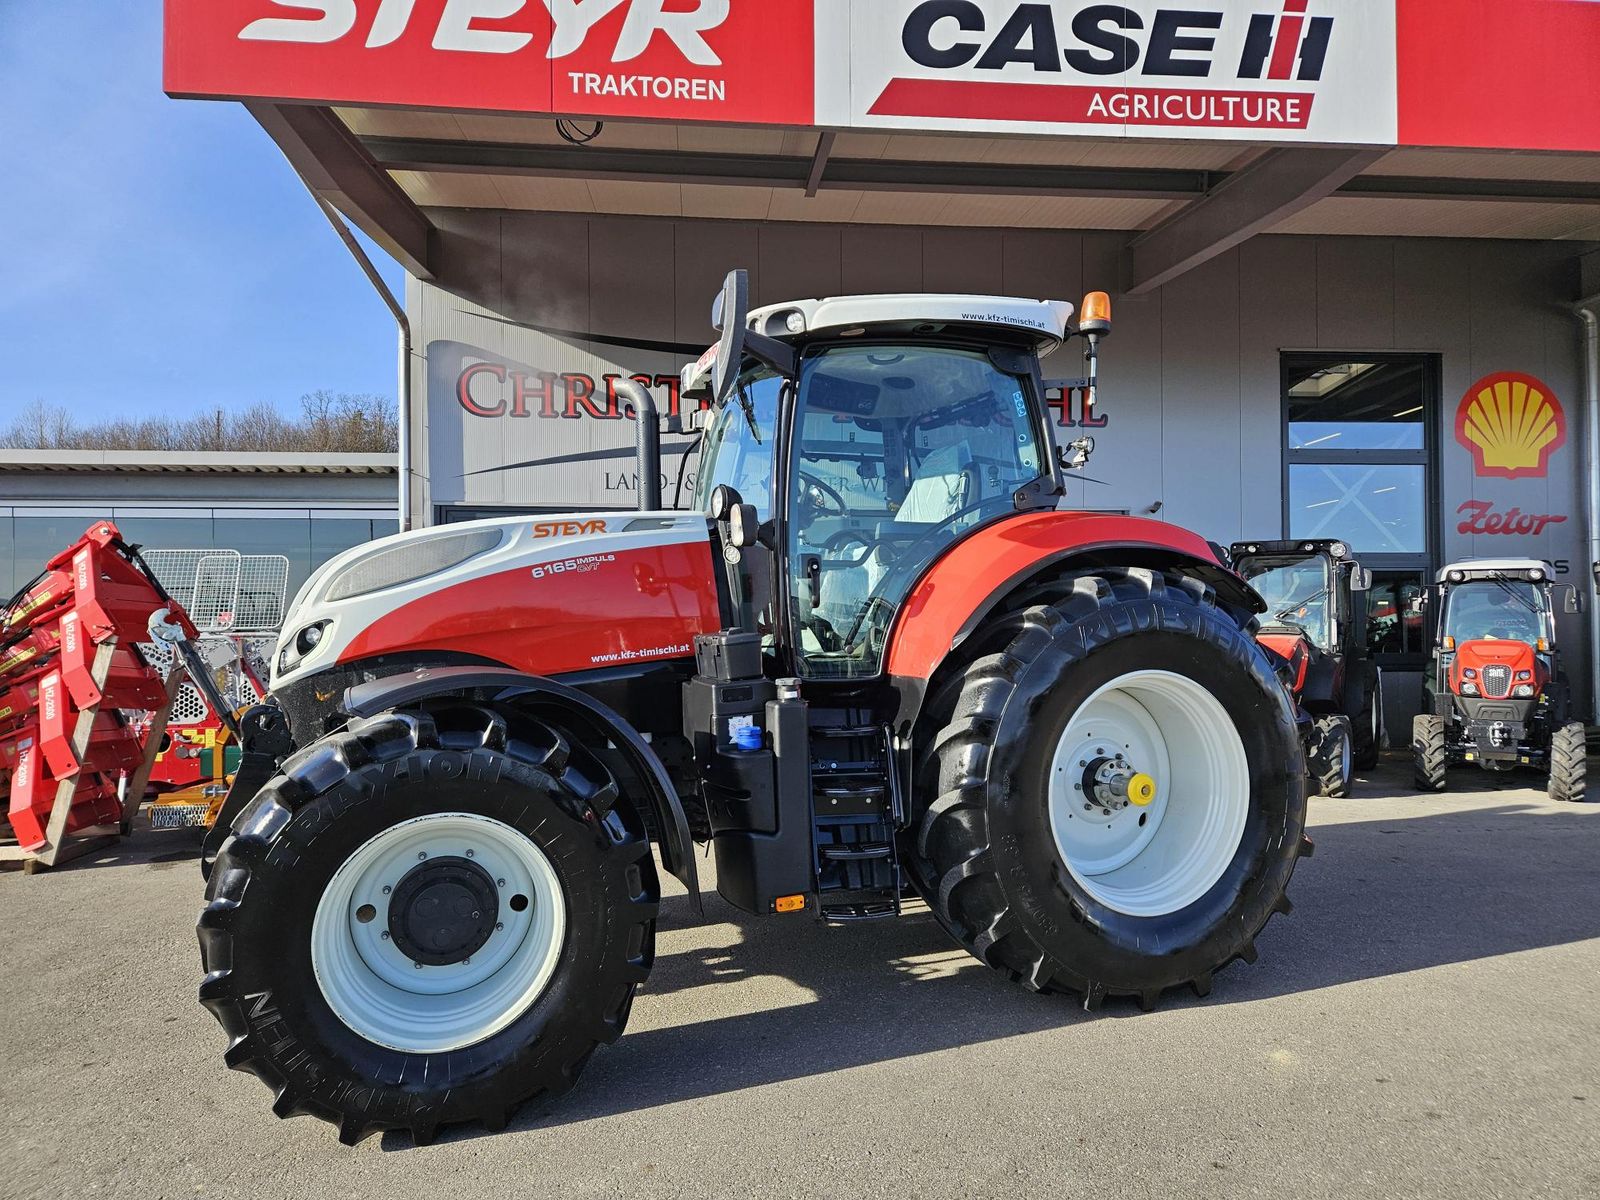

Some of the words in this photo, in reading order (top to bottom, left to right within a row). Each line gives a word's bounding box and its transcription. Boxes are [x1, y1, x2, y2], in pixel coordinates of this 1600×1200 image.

[901, 0, 1223, 78] CASE
[567, 71, 727, 102] TRAKTOREN
[1086, 92, 1302, 125] AGRICULTURE
[961, 312, 1046, 329] www.kfz-timischl.at
[531, 518, 607, 539] STEYR
[1456, 499, 1568, 536] Zetor
[531, 559, 577, 579] 6165
[576, 554, 616, 565] IMPULS
[590, 644, 690, 664] www.kfz-timischl.at
